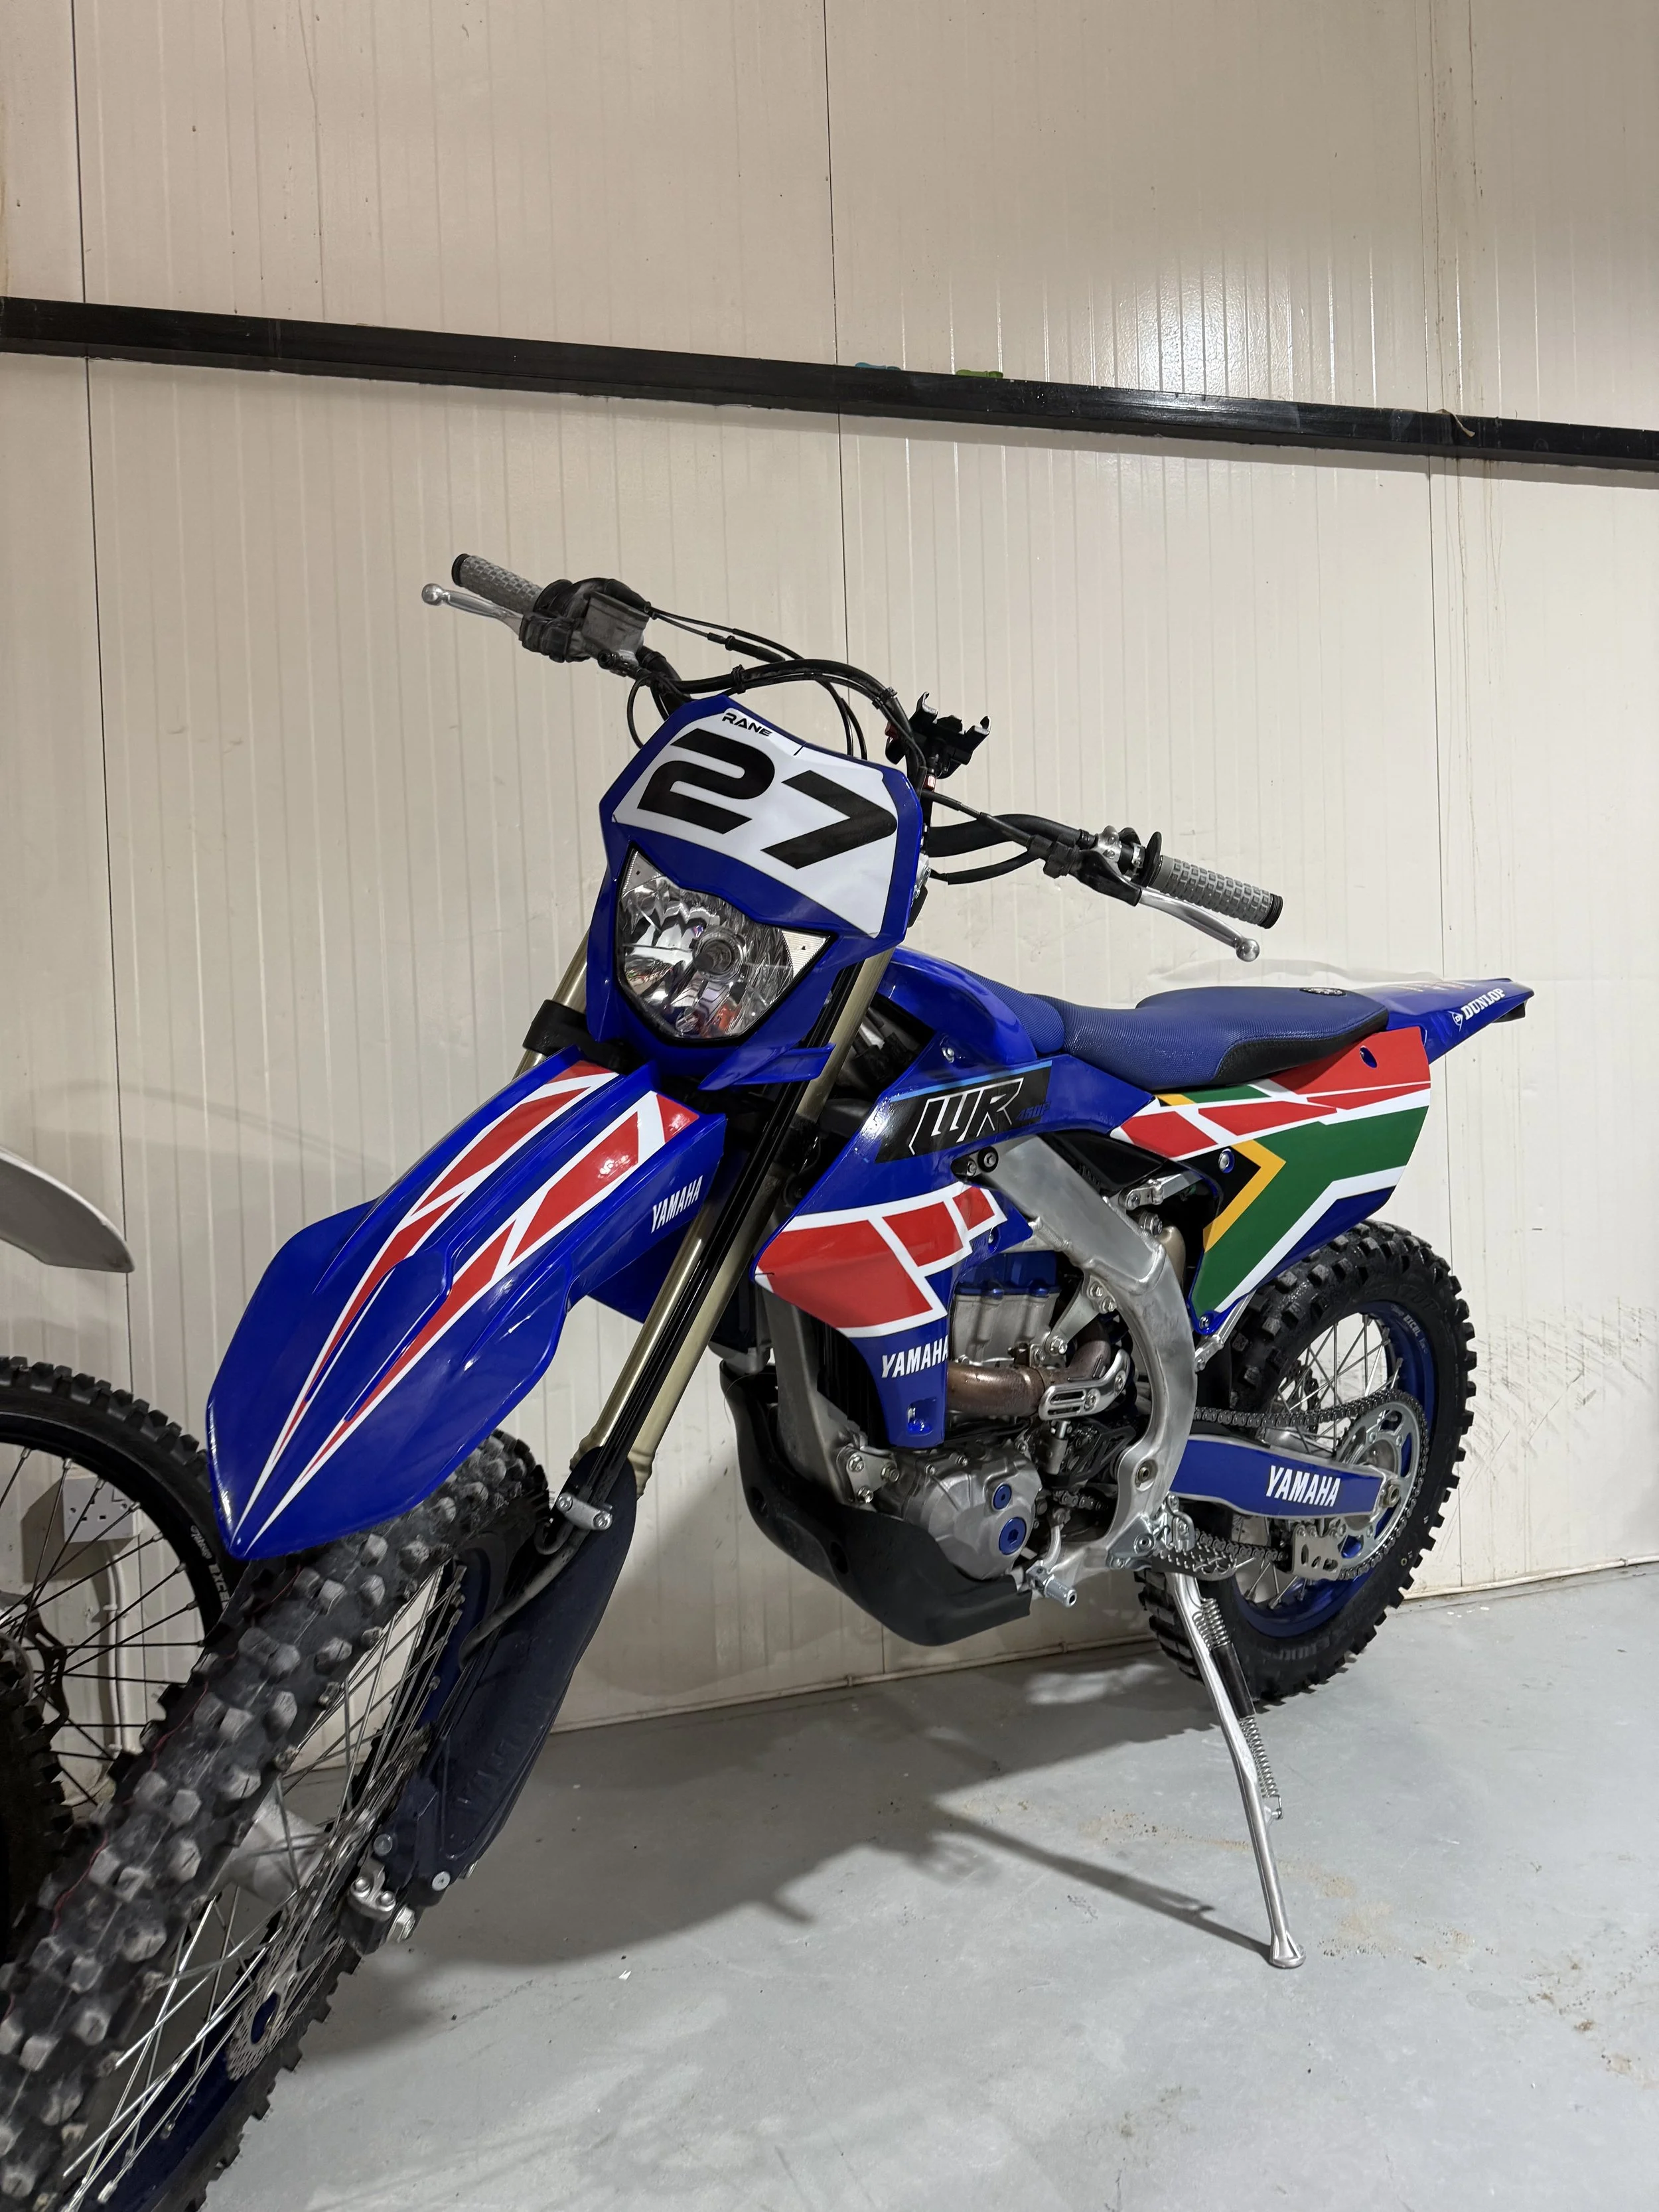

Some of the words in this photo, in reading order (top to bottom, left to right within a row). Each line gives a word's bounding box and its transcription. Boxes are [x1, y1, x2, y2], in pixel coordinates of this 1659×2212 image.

[722, 712, 772, 737] RANE
[636, 727, 898, 870] 27
[1461, 988, 1506, 1020] DUNLOP
[908, 1076, 1024, 1156] WR
[650, 1175, 703, 1234] YAMAHA
[1403, 1314, 1421, 1337] EXCEL
[881, 1334, 949, 1378] YAMAHA
[1265, 1465, 1341, 1507] YAMAHA
